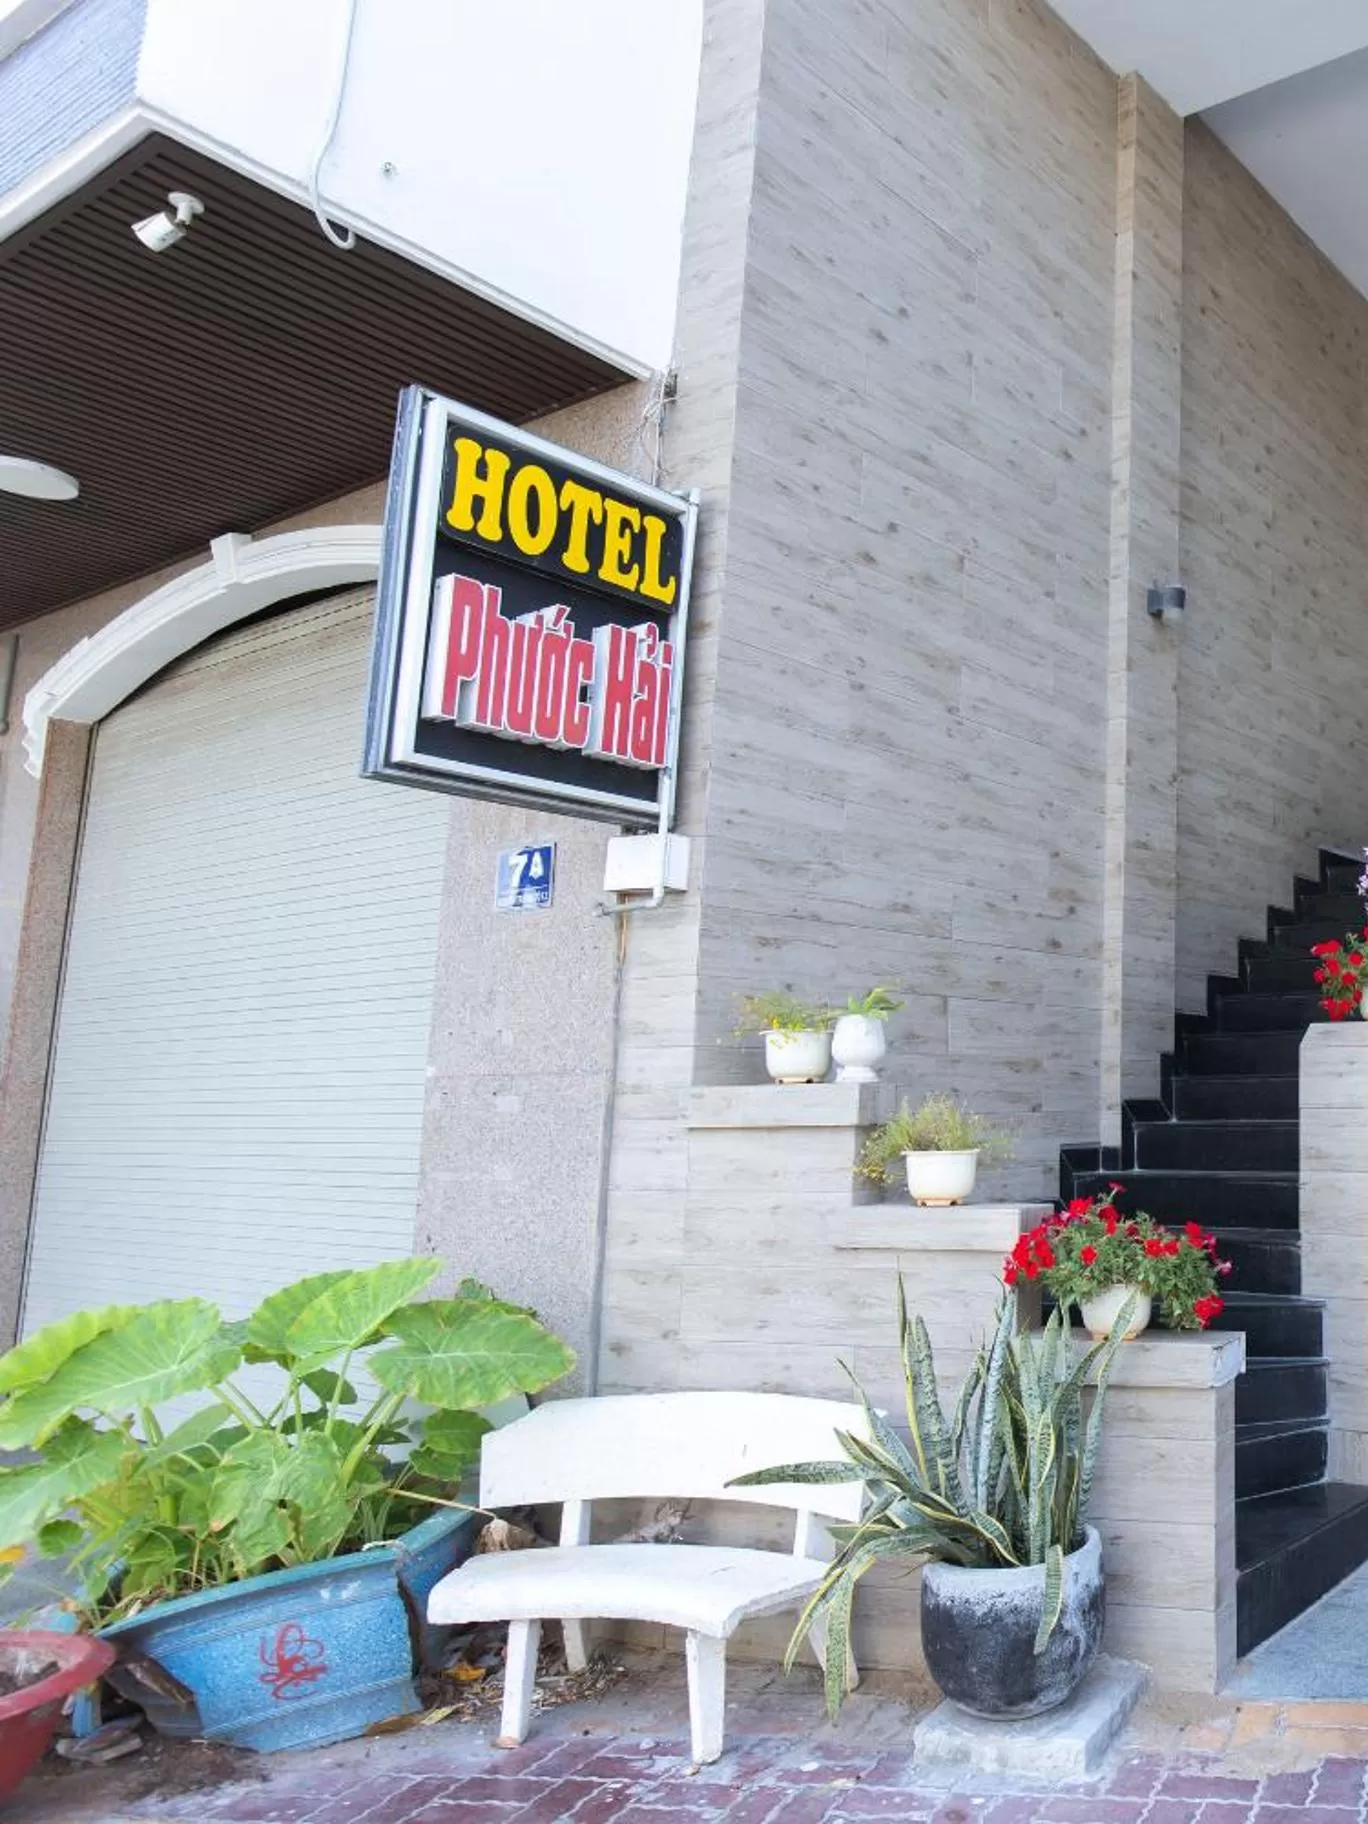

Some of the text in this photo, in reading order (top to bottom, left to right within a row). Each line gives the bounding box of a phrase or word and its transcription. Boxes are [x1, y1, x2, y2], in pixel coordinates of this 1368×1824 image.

[446, 438, 677, 605] HOTEL
[440, 573, 675, 768] Phước Hải
